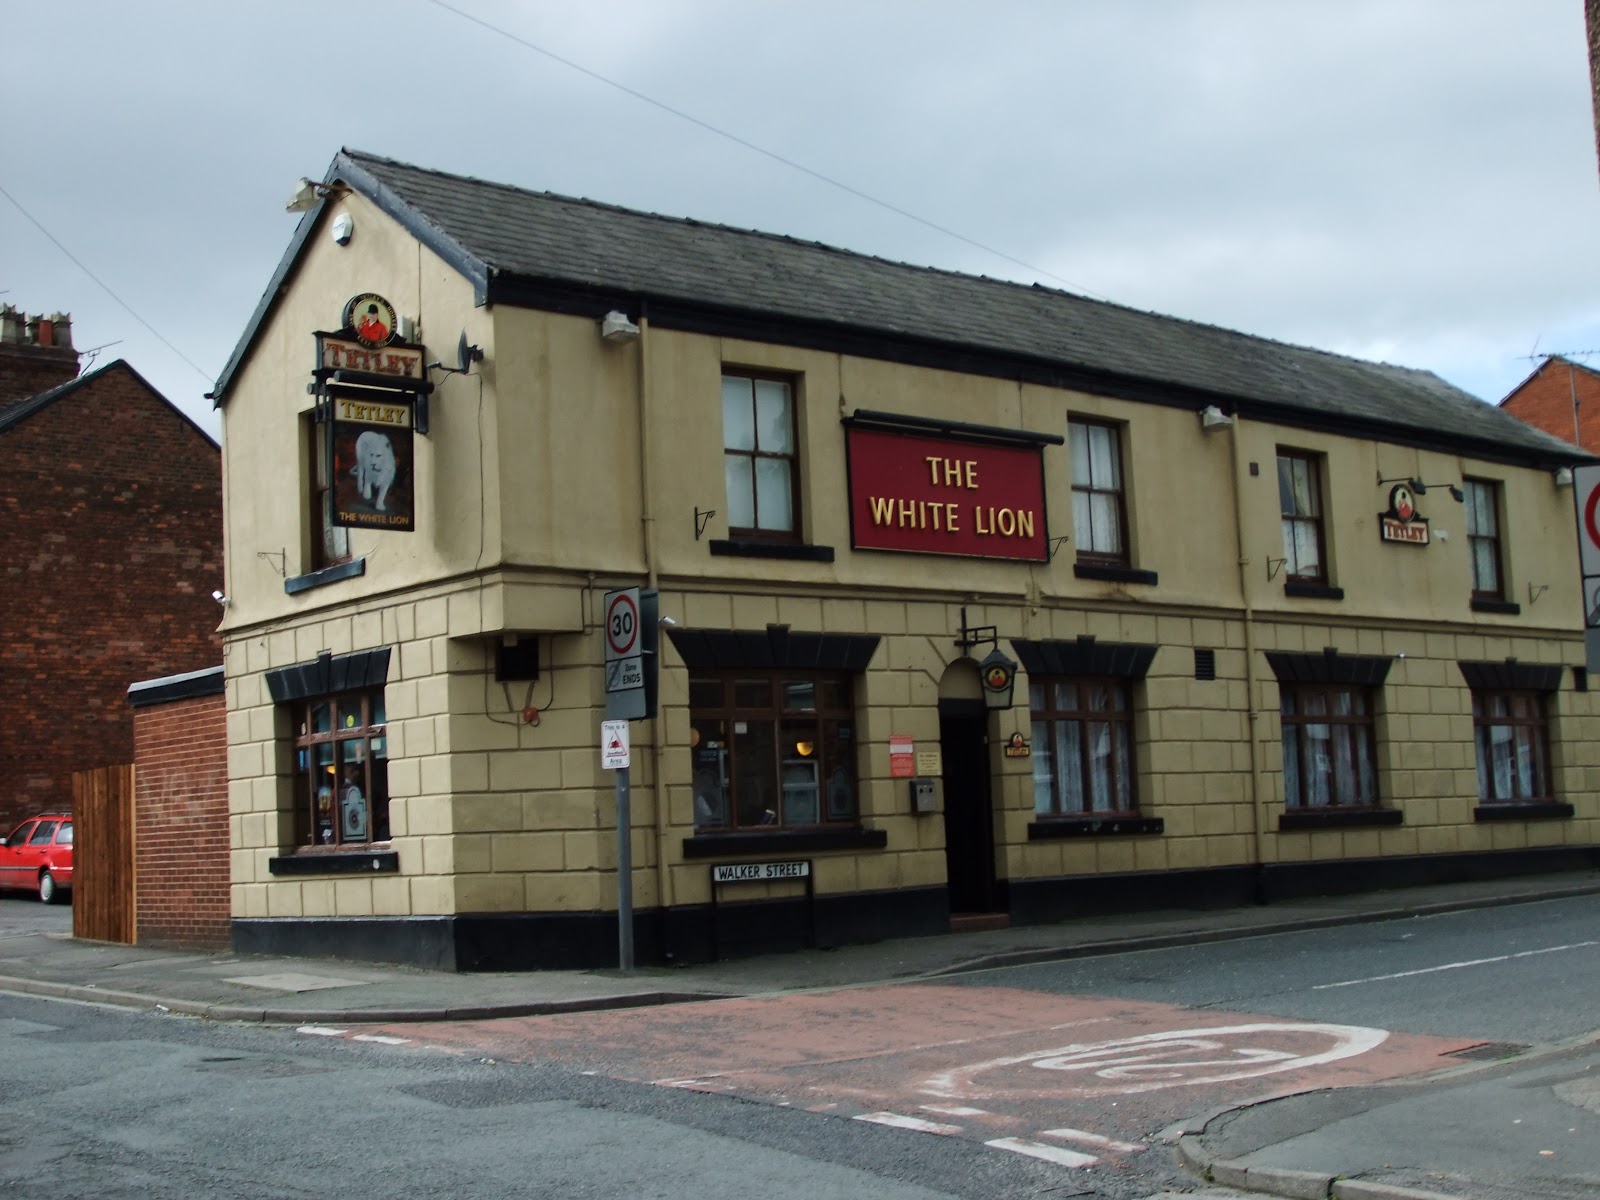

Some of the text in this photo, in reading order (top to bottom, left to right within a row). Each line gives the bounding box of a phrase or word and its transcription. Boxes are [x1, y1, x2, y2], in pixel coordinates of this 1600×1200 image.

[327, 342, 419, 376] TETLEY
[341, 401, 405, 424] TETLEY
[926, 456, 979, 489] THE
[339, 511, 409, 525] THE WHITE LION
[870, 496, 1034, 538] WHITE LION
[612, 611, 632, 637] 30
[622, 673, 641, 685] ENDS
[624, 663, 638, 672] Zone
[718, 862, 804, 880] WALKER STREET
